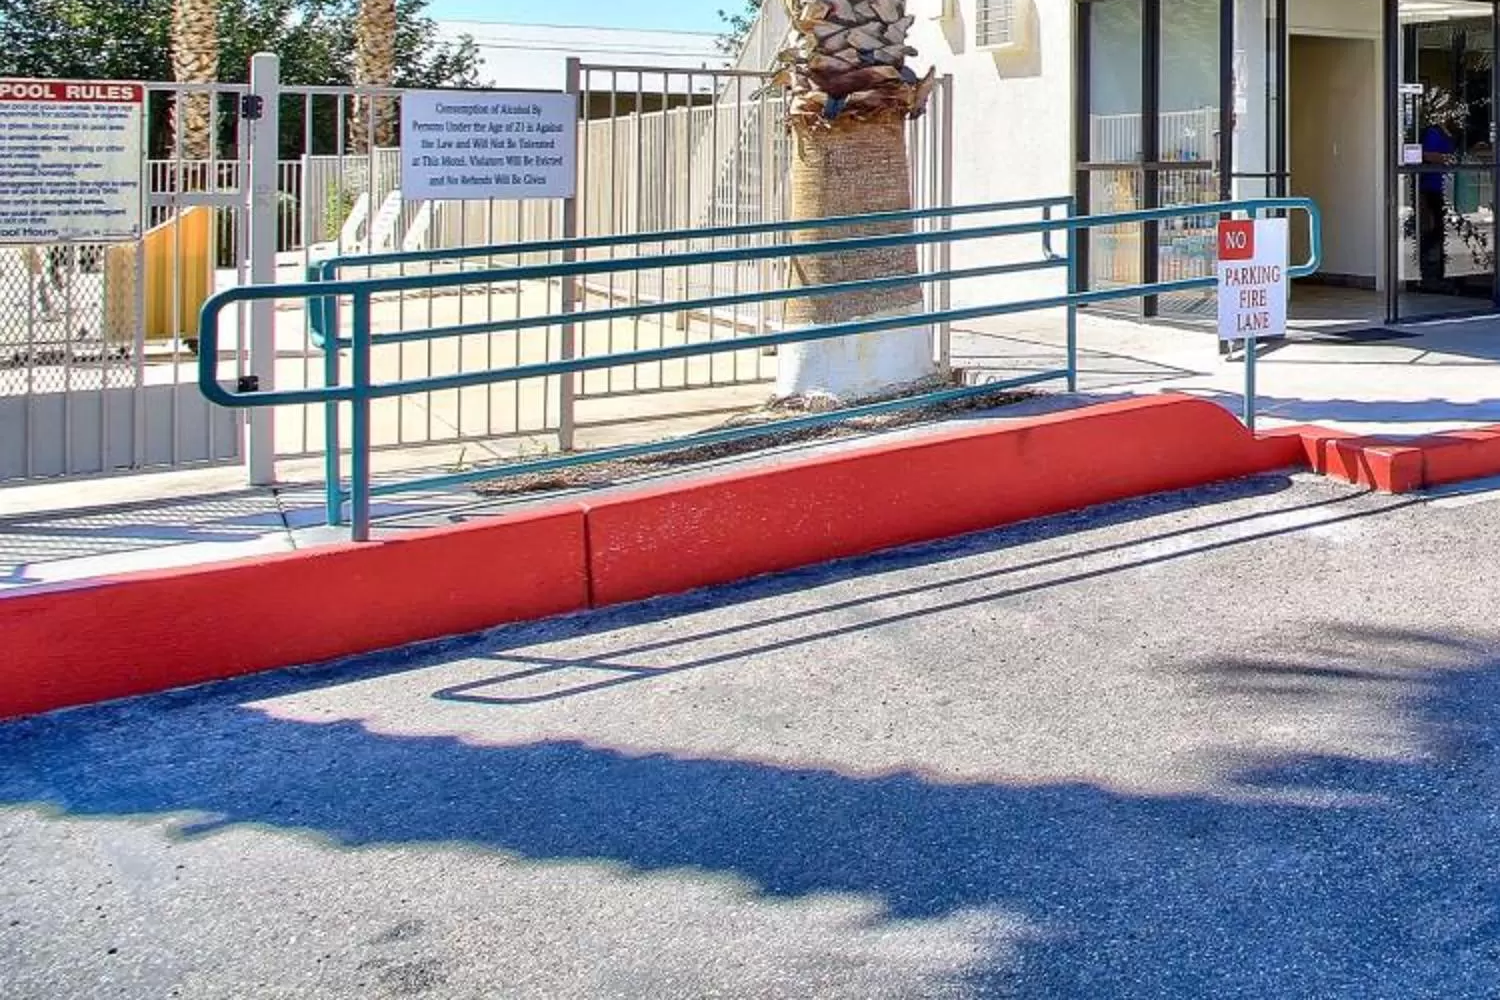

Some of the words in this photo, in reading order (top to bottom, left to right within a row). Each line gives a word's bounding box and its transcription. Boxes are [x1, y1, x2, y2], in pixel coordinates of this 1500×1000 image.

[0, 83, 57, 99] POOL
[66, 85, 135, 100] RULES
[0, 228, 19, 237] ool
[1225, 231, 1247, 249] NO
[1225, 265, 1281, 286] PARKING
[1239, 289, 1267, 309] FIRE
[1236, 312, 1270, 332] LANE
